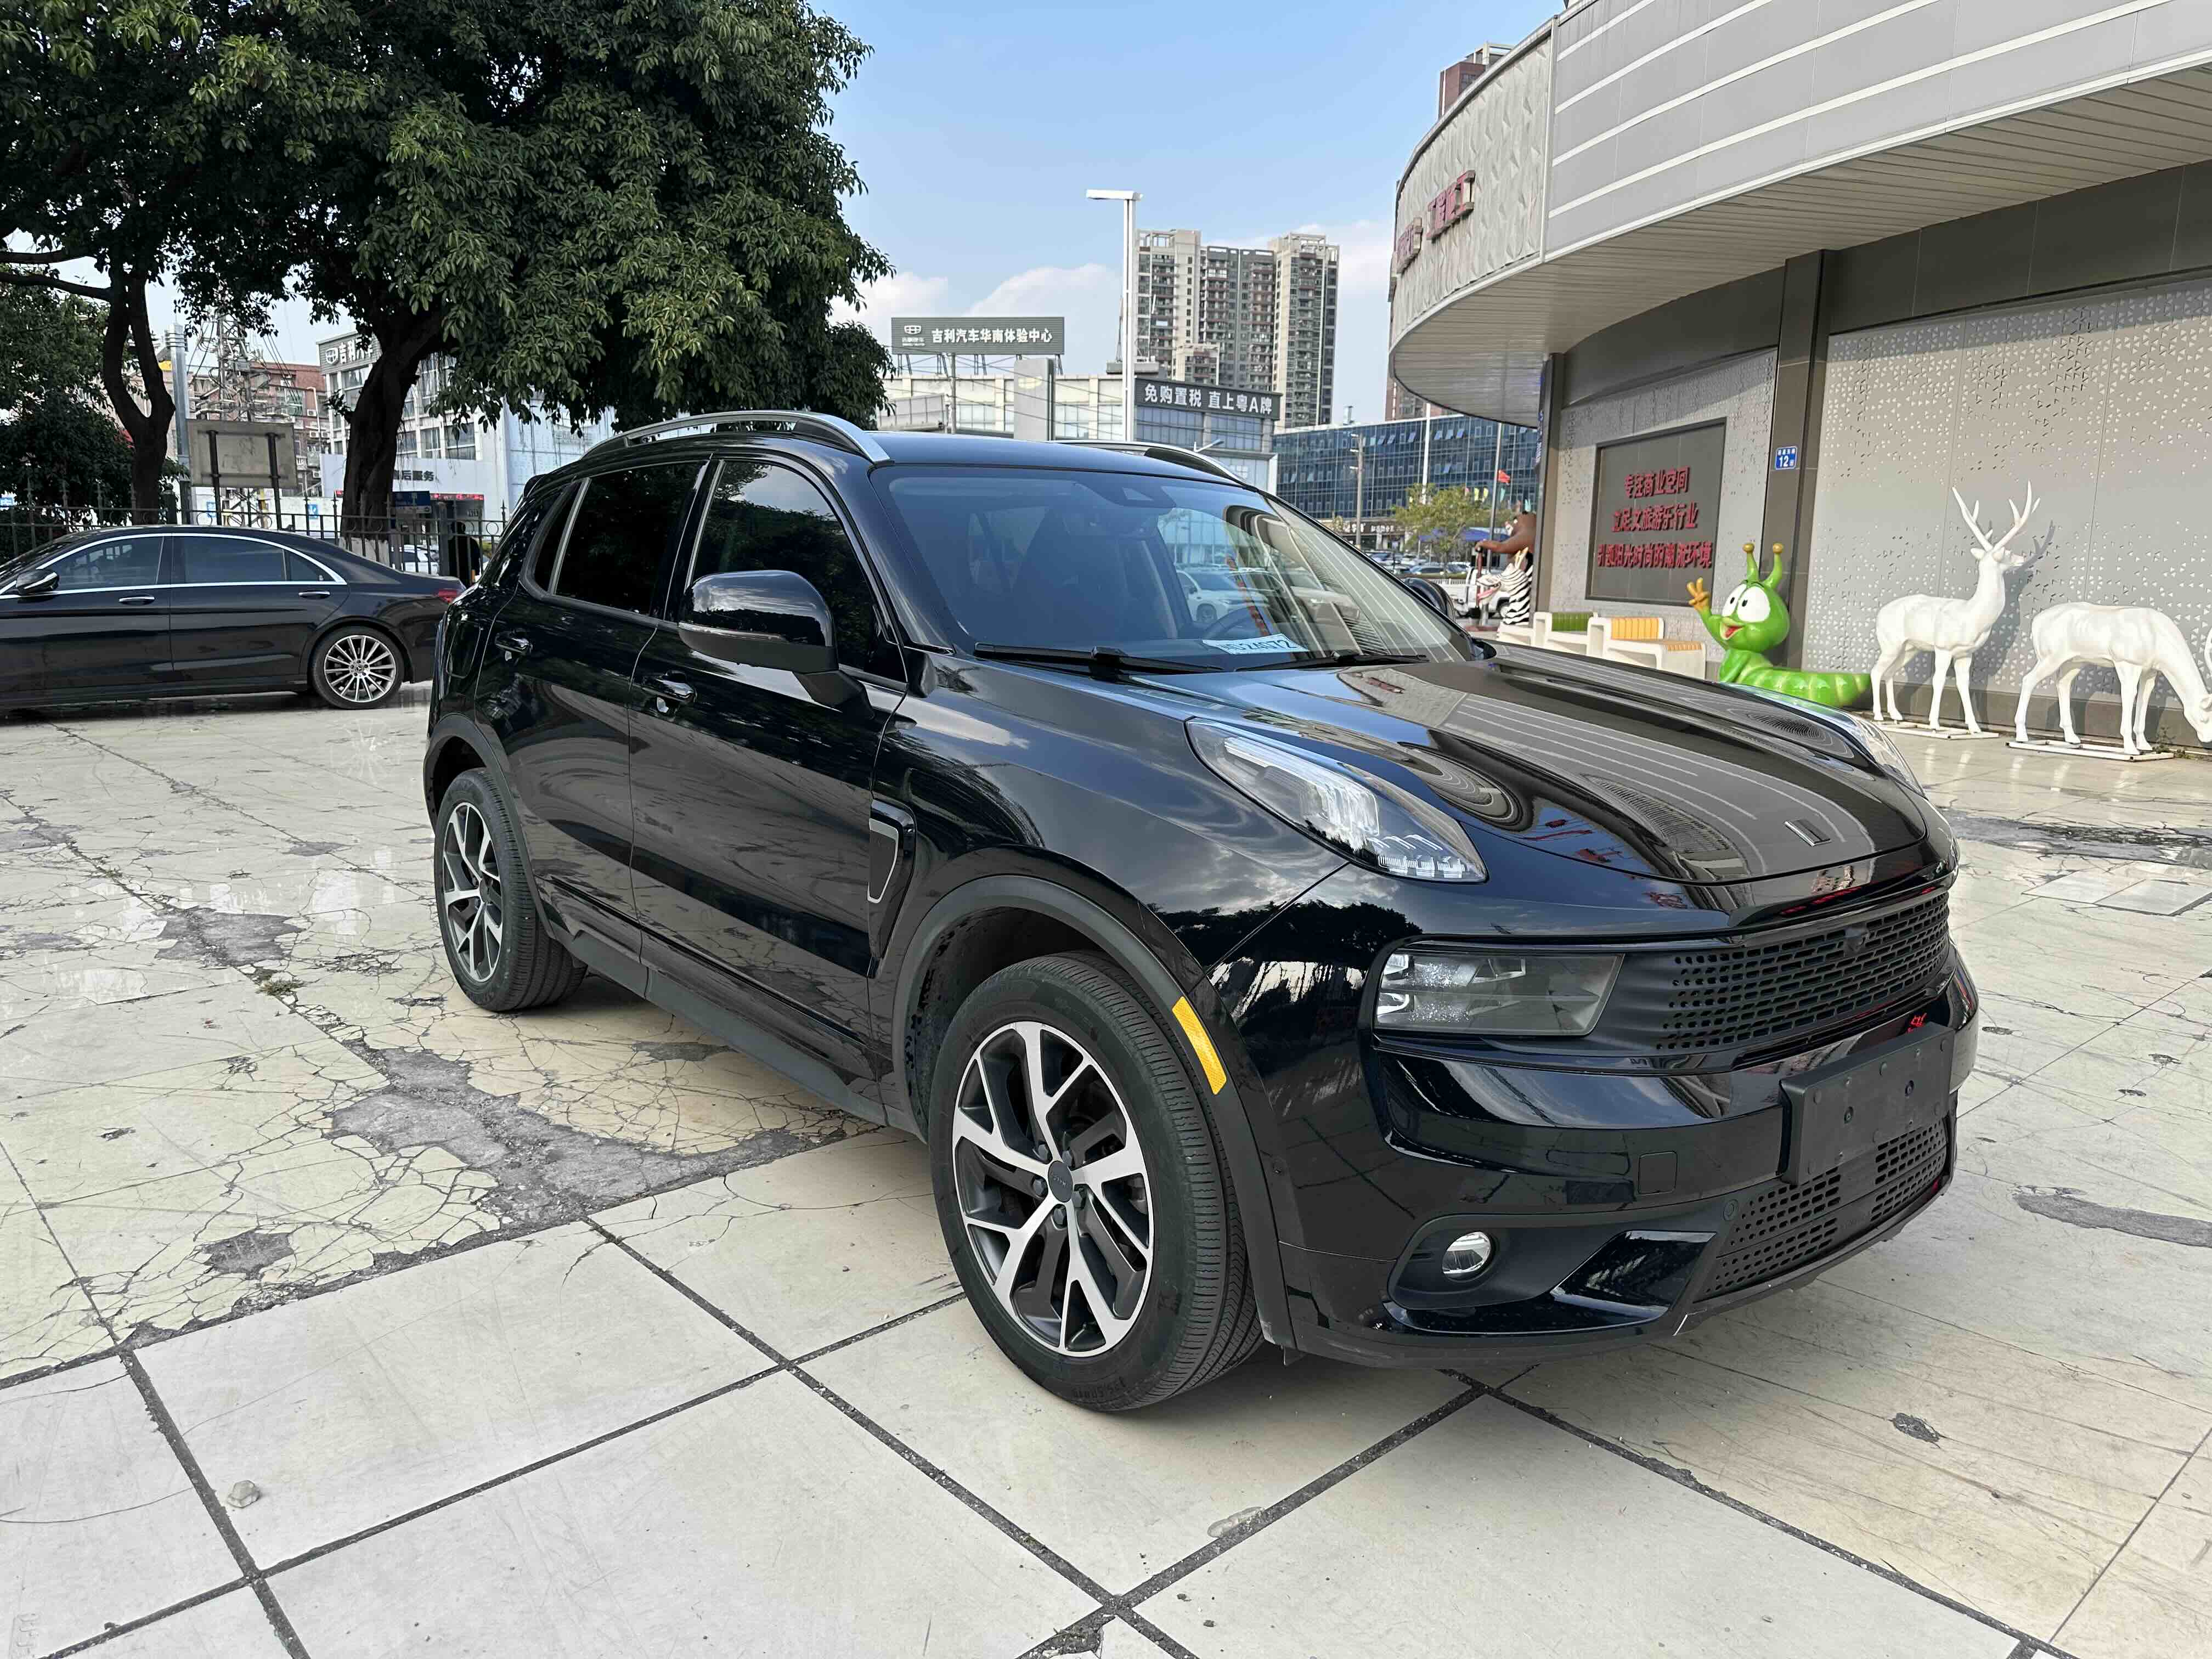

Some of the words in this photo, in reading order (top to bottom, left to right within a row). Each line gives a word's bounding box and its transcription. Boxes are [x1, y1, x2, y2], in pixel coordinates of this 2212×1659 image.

[932, 328, 1053, 343] 吉利汽车华南体验中心
[1145, 383, 1202, 408] 免购置税
[1208, 391, 1272, 415] 直上粤A牌
[1624, 466, 1690, 498] 专注商业空间
